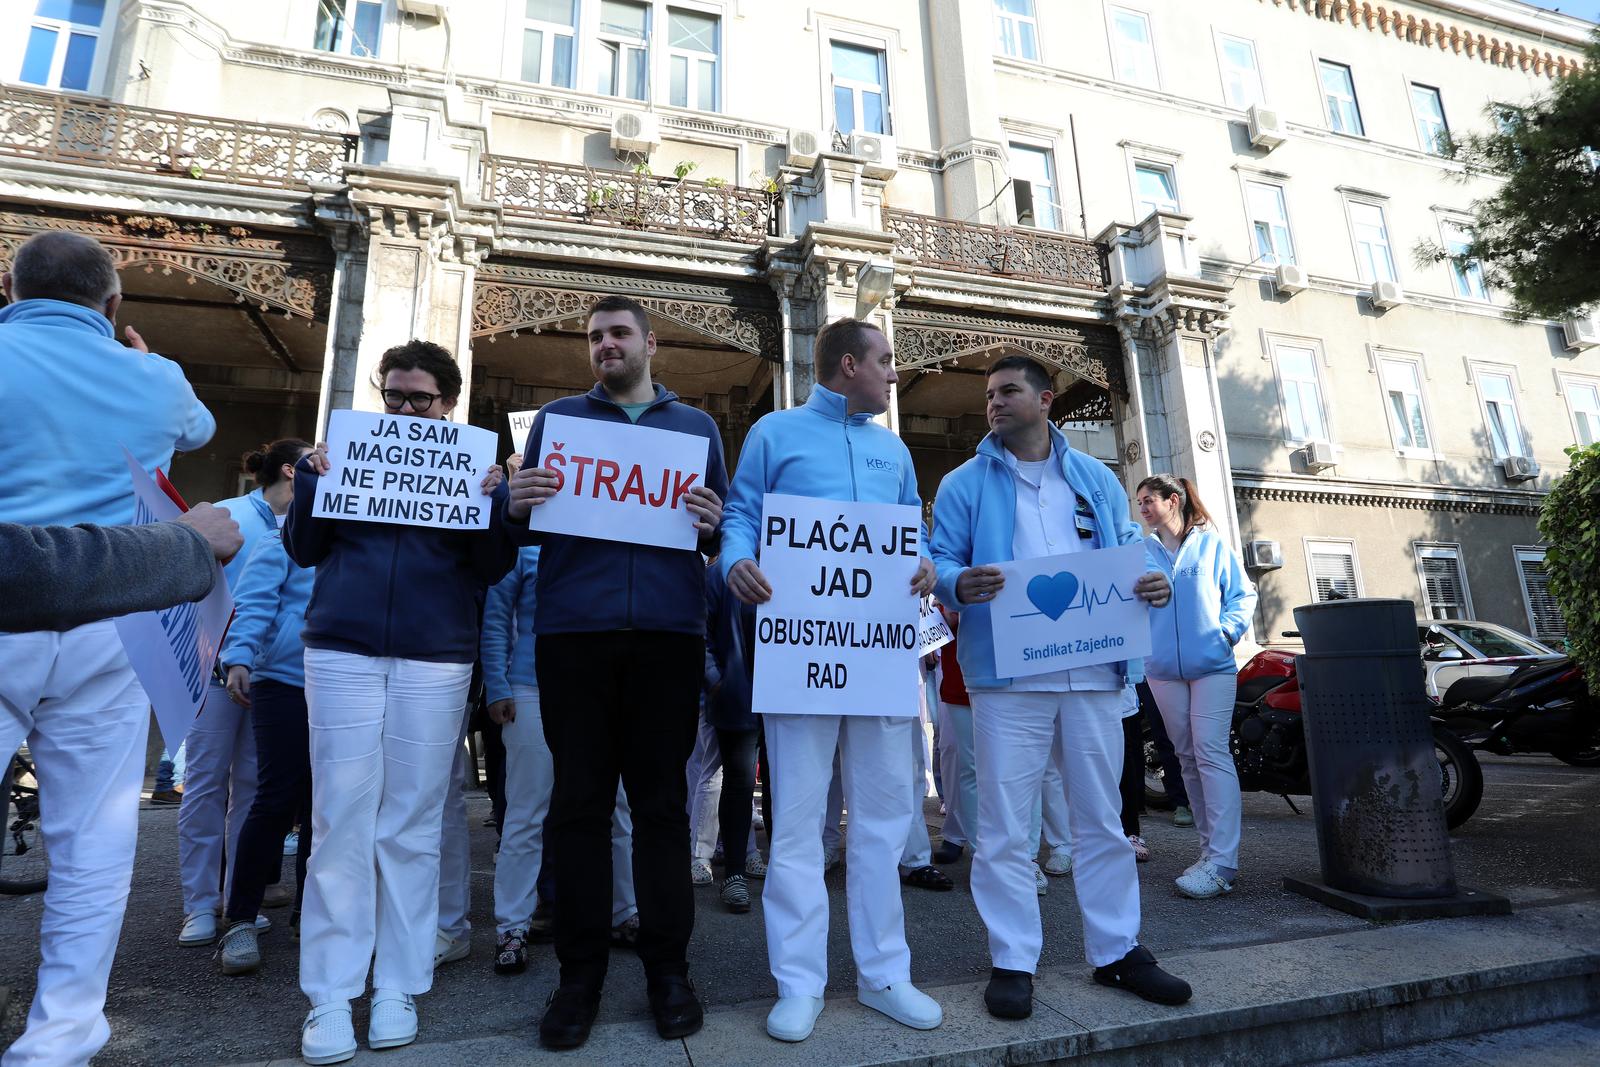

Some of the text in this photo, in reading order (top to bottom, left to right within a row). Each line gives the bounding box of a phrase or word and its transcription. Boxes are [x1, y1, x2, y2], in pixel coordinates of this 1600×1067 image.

[371, 418, 459, 446] JA SAM
[513, 416, 534, 430] HU
[347, 440, 477, 477] MAGISTAR,
[341, 466, 470, 499] NE PRIZNA
[544, 441, 699, 511] ŠTRAJK
[322, 492, 481, 526] ME MINISTAR
[766, 513, 918, 557] PLAĆA JE
[811, 565, 873, 599] JAD
[758, 616, 917, 650] OBUSTAVLJAMO
[1023, 634, 1125, 661] Sindikat Zajedno
[806, 662, 848, 690] RAD
